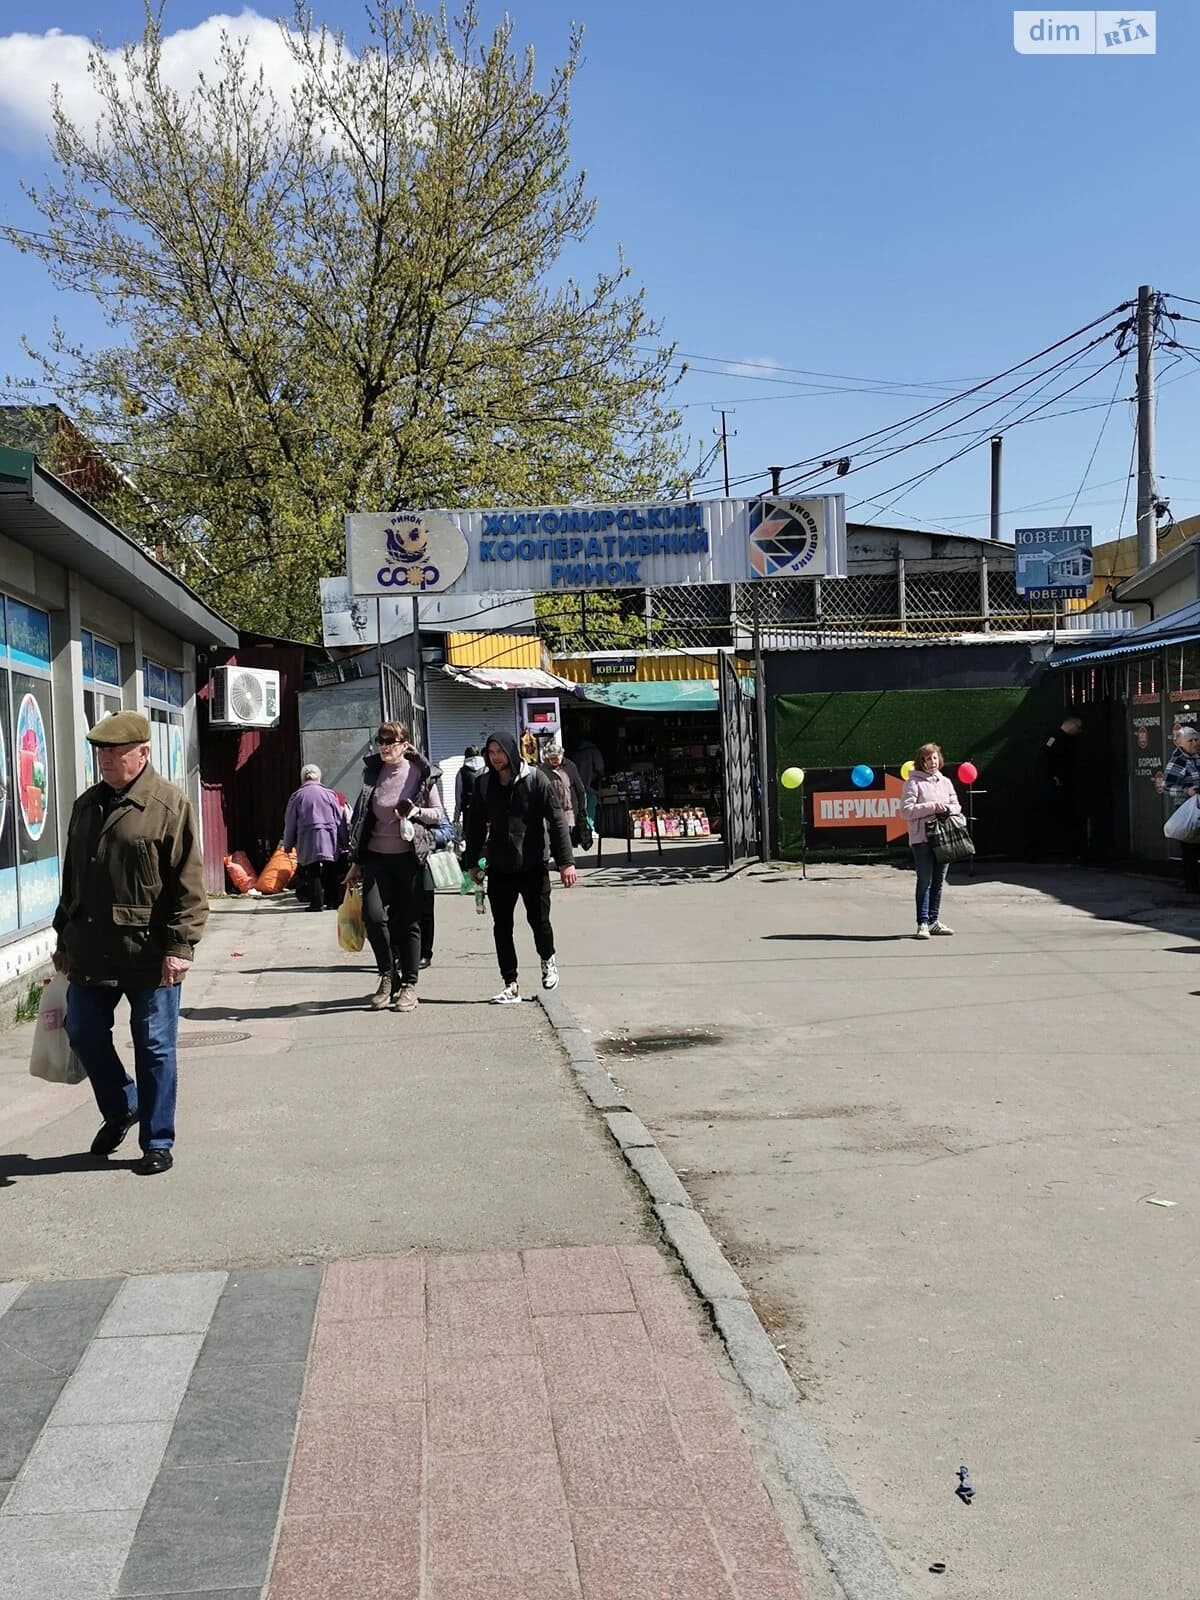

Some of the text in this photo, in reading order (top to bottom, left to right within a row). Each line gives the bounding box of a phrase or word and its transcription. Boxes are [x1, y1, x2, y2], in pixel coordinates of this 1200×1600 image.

[391, 515, 423, 525] РИНОК
[482, 503, 703, 536] ЖИТОМИРСЬКИЙ
[479, 528, 709, 562] КООПЕРАТИВНИЙ
[1017, 529, 1090, 545] ЮВЕЛІР
[552, 560, 642, 586] РИНОК
[1029, 588, 1083, 600] ЮВЕЛІР
[596, 664, 636, 674] ЮВЕЛІР
[820, 798, 901, 820] ПЕРУКАР
